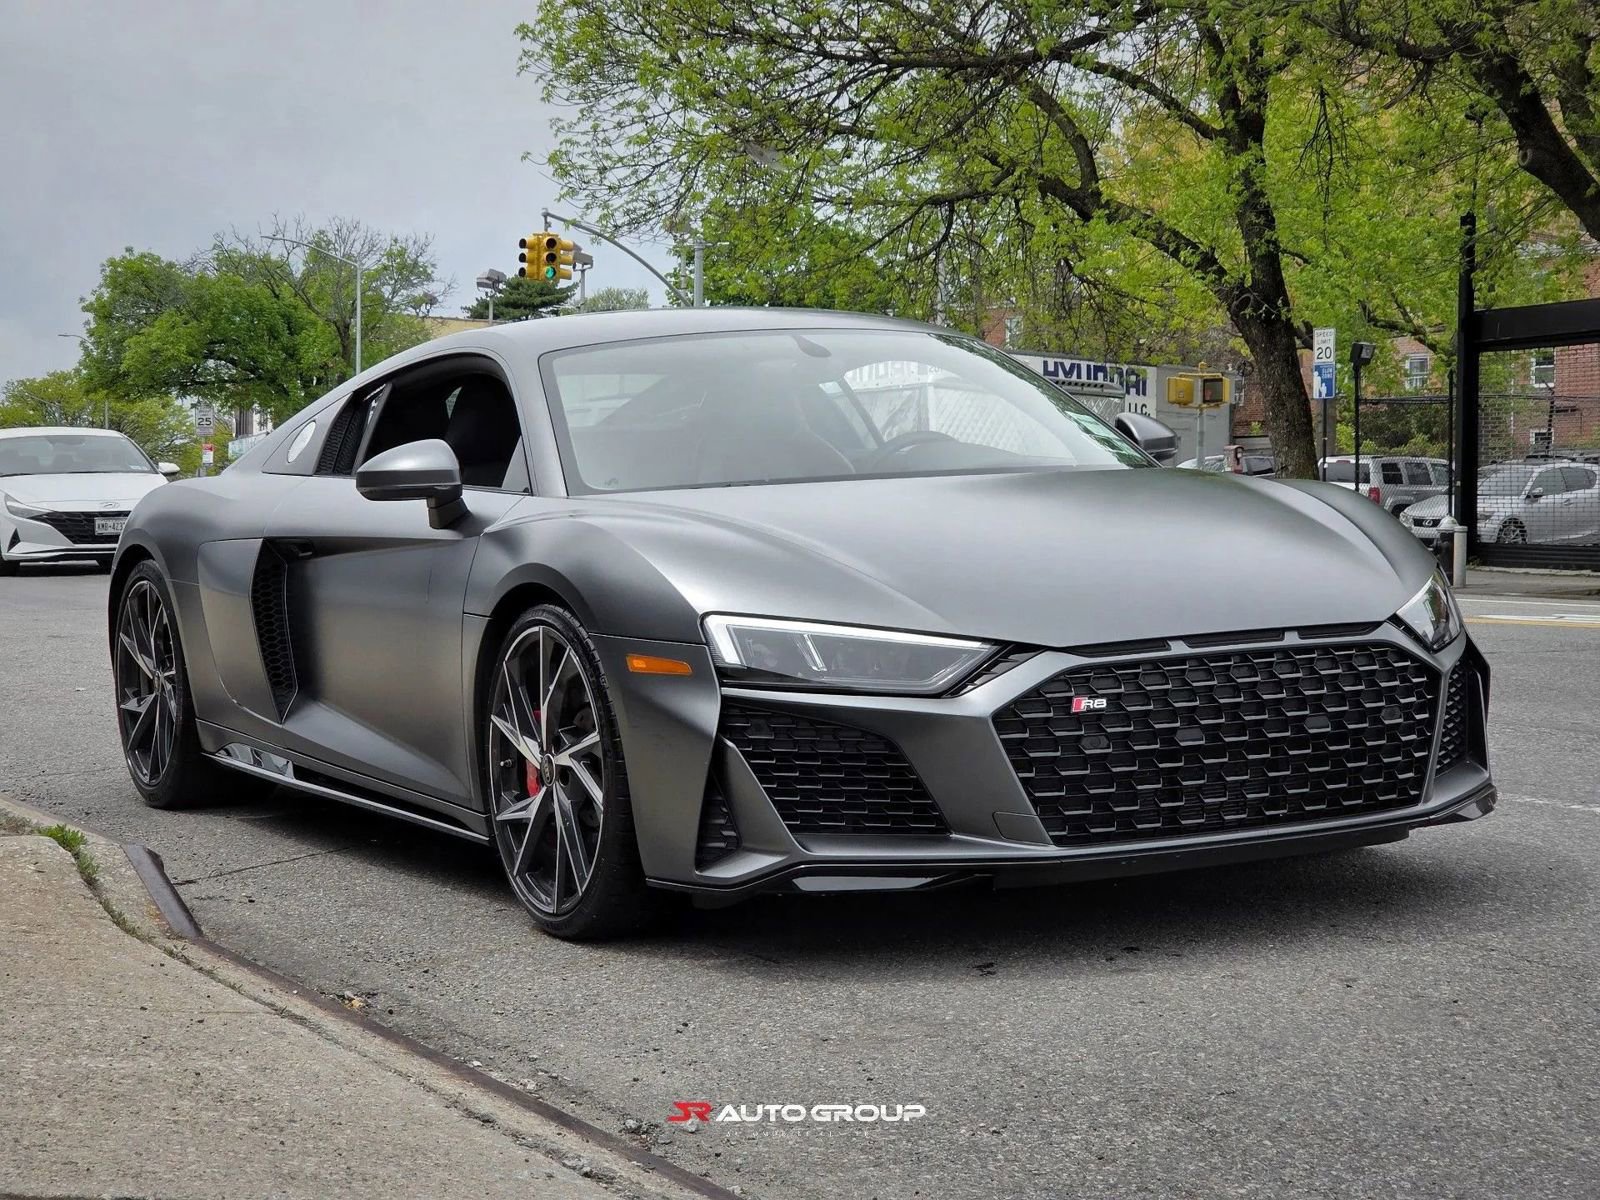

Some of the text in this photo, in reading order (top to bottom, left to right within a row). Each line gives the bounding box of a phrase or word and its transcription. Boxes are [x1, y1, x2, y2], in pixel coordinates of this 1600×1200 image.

[1317, 347, 1332, 359] 20
[197, 417, 212, 426] 25
[1080, 699, 1107, 710] R8
